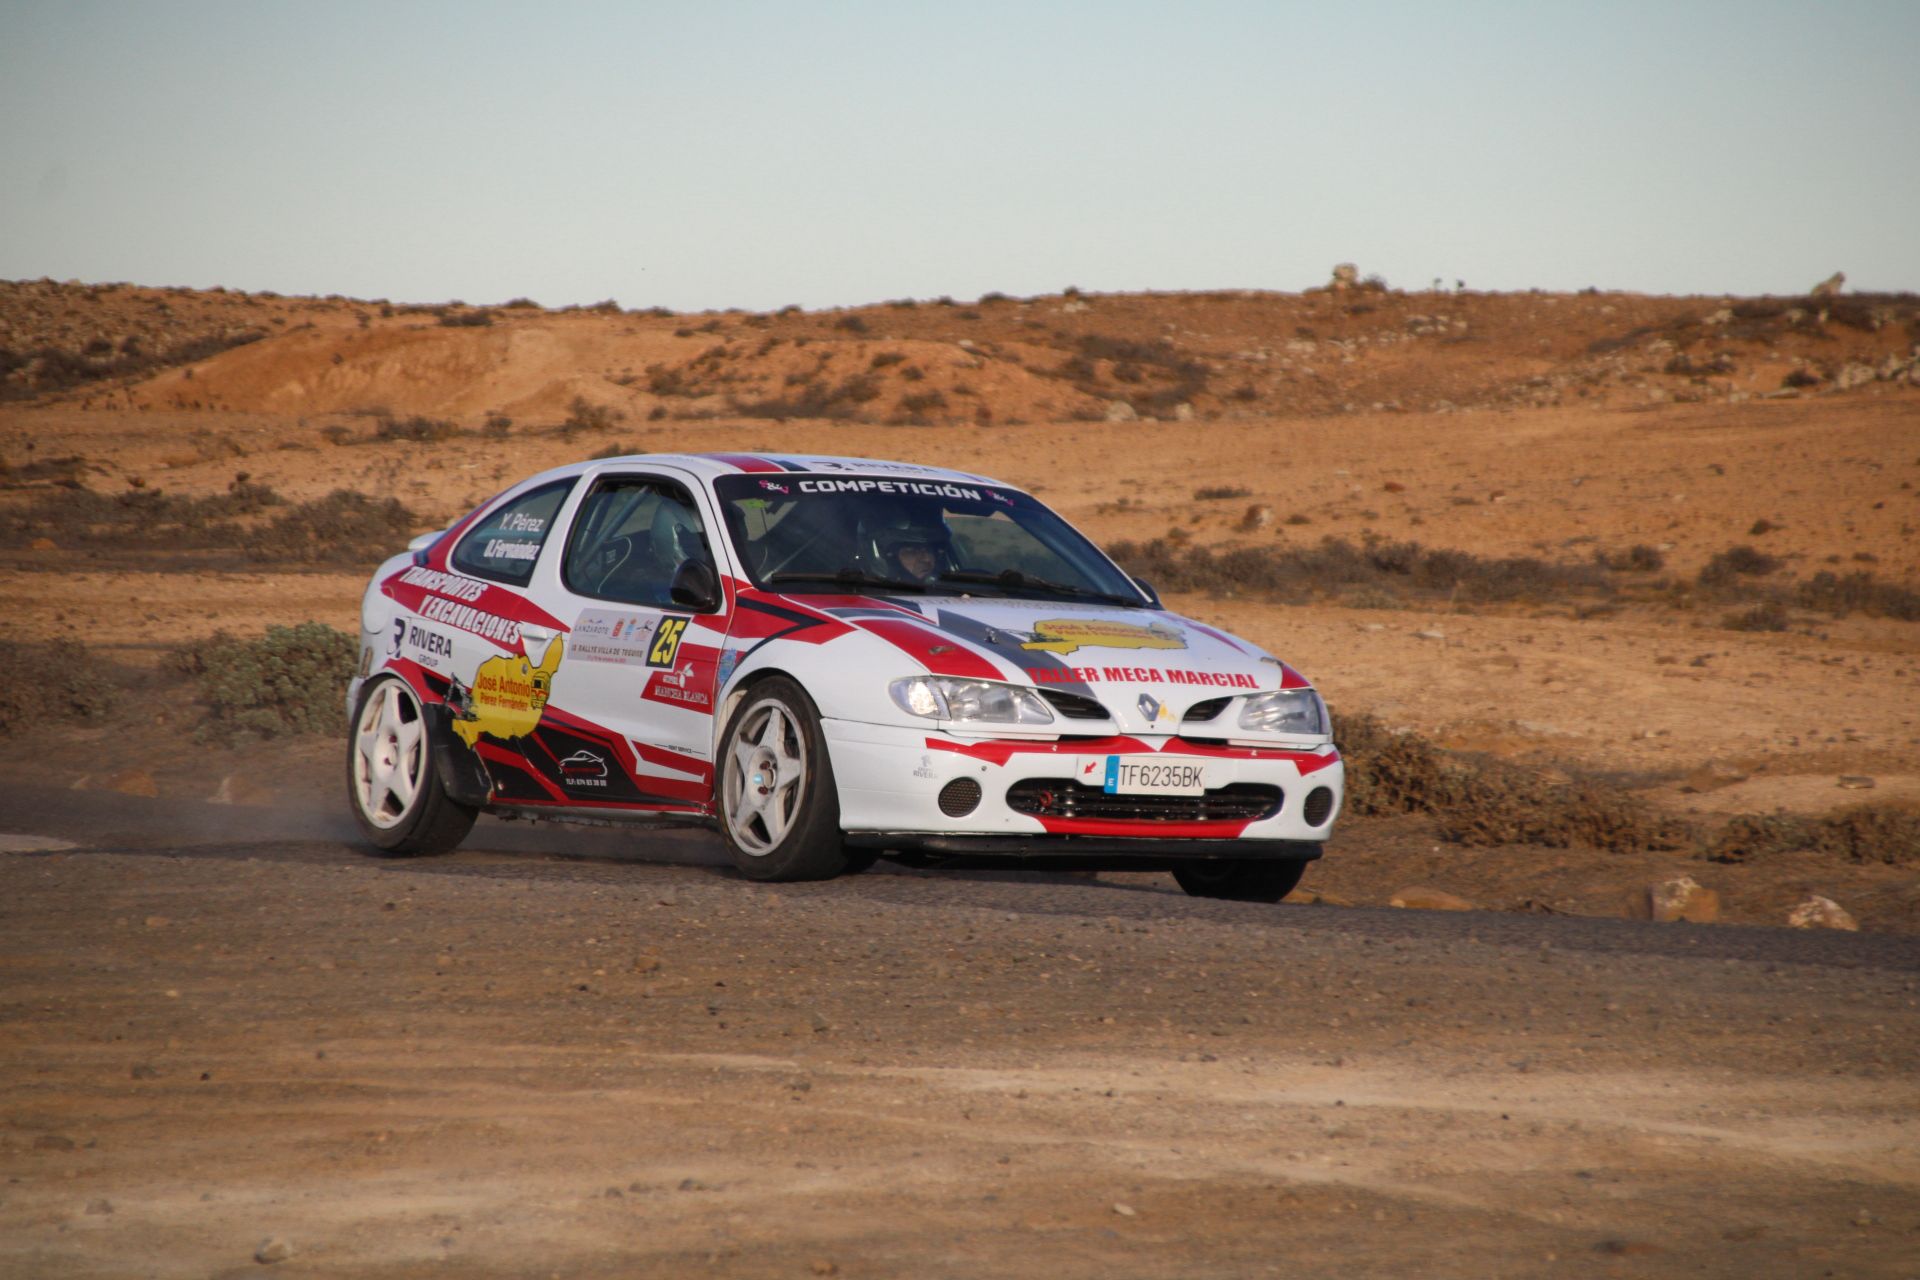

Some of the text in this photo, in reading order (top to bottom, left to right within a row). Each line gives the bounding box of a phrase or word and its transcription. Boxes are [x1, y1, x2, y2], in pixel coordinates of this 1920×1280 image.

[799, 480, 982, 501] COMPETICIÓN
[509, 513, 545, 532] Pérez
[398, 565, 489, 602] TRANSPORTES
[418, 594, 521, 645] Y EXCAVACIONES
[574, 624, 609, 634] LANZAROTE
[409, 626, 452, 658] RIVERA
[649, 619, 686, 664] 25
[418, 654, 438, 667] GROUP
[499, 676, 530, 697] Antonio
[1024, 666, 1260, 689] TALLER MECA MARCIAL
[1108, 778, 1115, 786] E
[1120, 765, 1204, 787] TF6235BK
